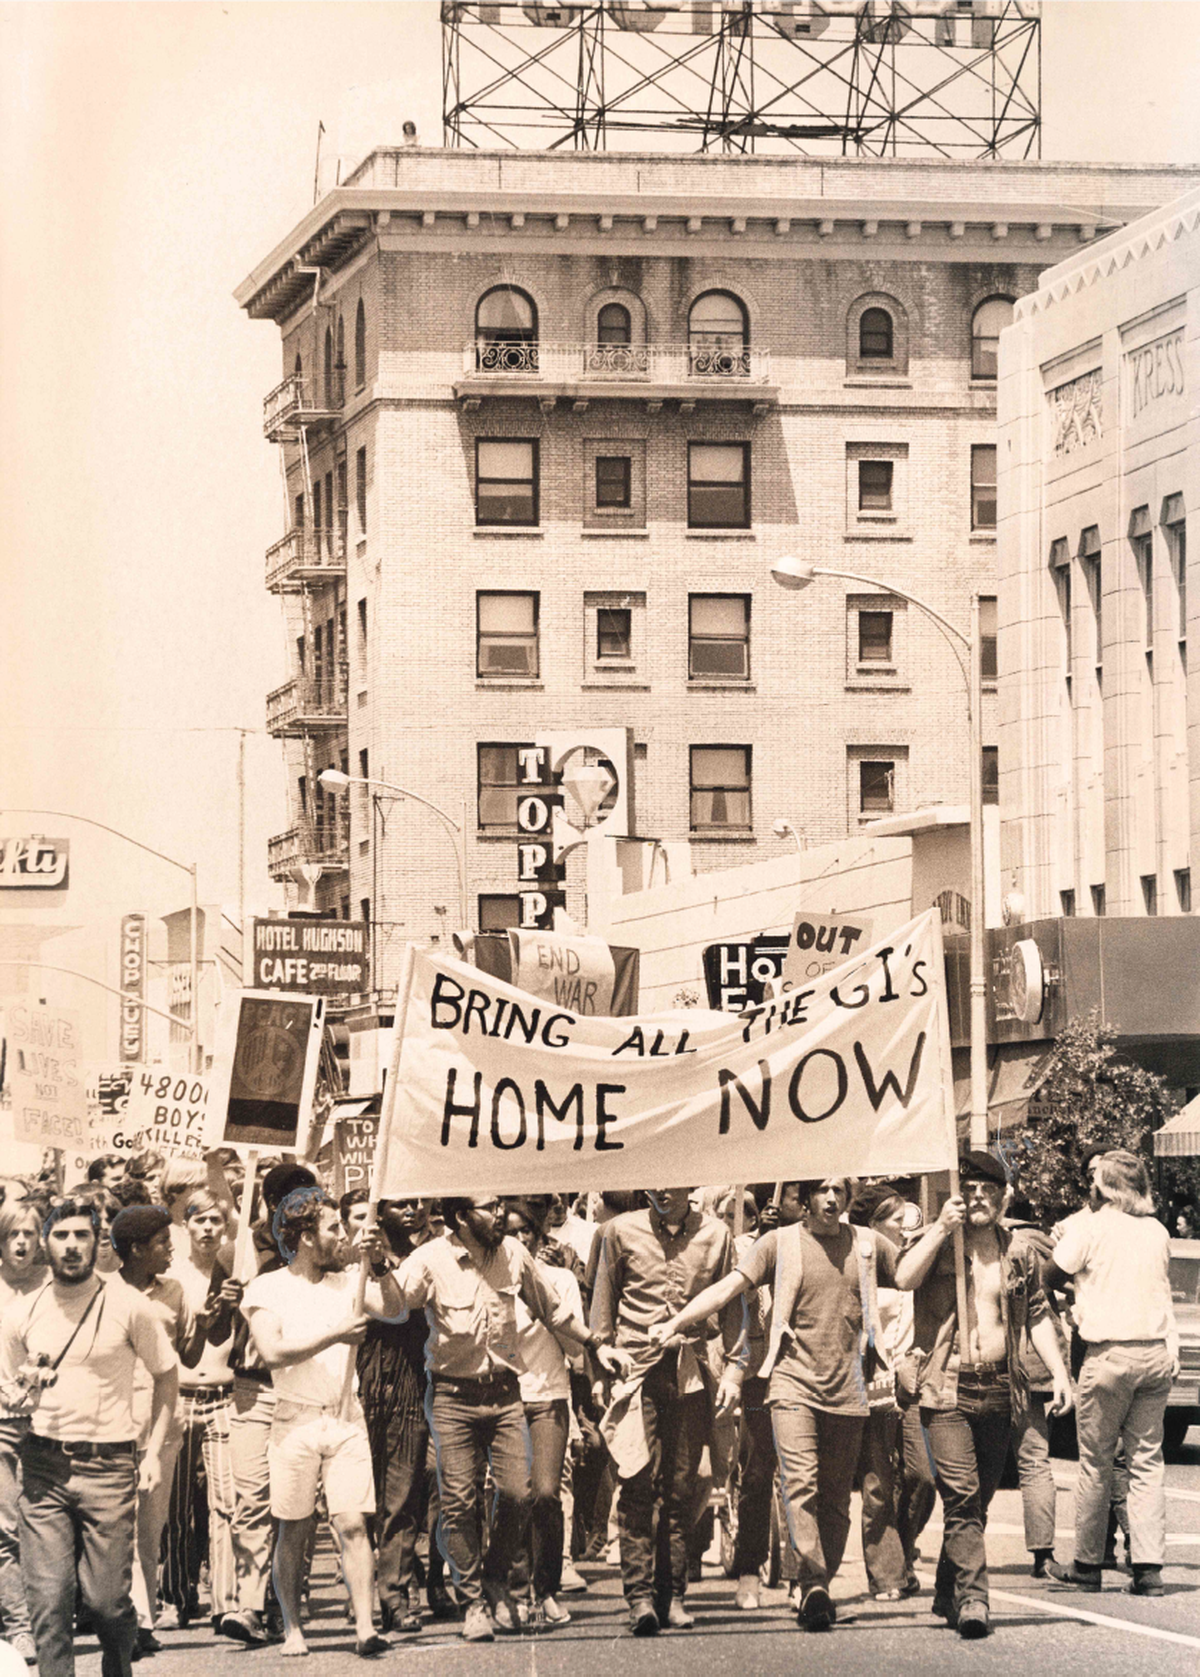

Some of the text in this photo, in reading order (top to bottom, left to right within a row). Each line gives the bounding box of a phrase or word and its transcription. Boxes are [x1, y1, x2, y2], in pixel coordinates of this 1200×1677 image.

[1132, 336, 1185, 418] KRESS
[256, 925, 363, 952] HOTEL HUGHSON
[797, 922, 862, 955] OUT
[260, 958, 308, 984] CAFE
[537, 945, 580, 975] END
[720, 946, 783, 985] HO
[805, 961, 836, 978] OF
[554, 976, 598, 1016] WAR
[11, 1005, 75, 1049] SAVE
[430, 972, 576, 1048] BRING
[612, 1026, 698, 1057] ALL
[737, 990, 816, 1043] THE
[17, 1049, 78, 1087] LIVES
[35, 1084, 58, 1097] NOT
[140, 1073, 209, 1105] 4800
[441, 1031, 927, 1151] HOME NOW
[90, 1137, 107, 1149] ith
[346, 1120, 374, 1134] TO
